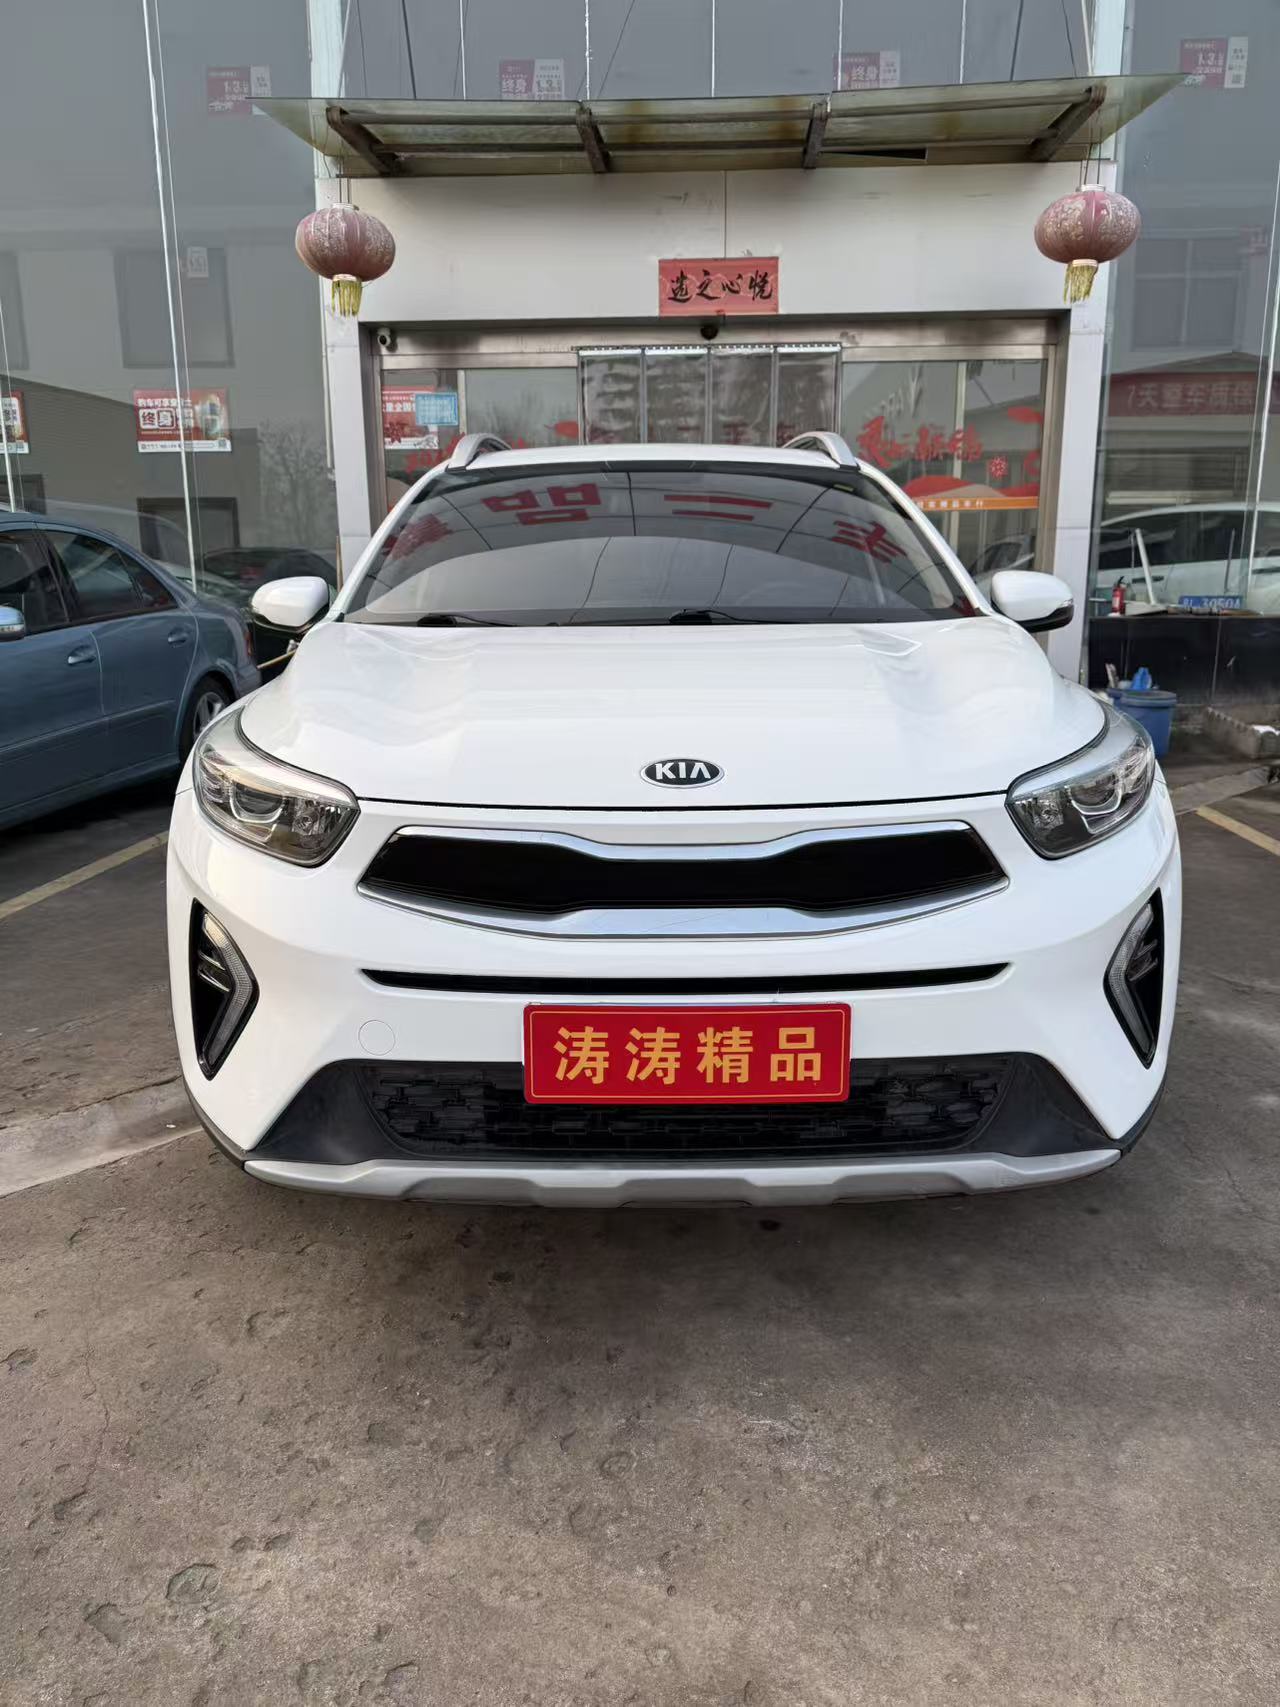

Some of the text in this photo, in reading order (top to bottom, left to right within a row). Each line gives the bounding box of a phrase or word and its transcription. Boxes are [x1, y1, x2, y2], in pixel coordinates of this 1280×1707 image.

[140, 410, 174, 428] 终身
[655, 762, 711, 780] KIA
[553, 1026, 822, 1085] 涛涛精品
